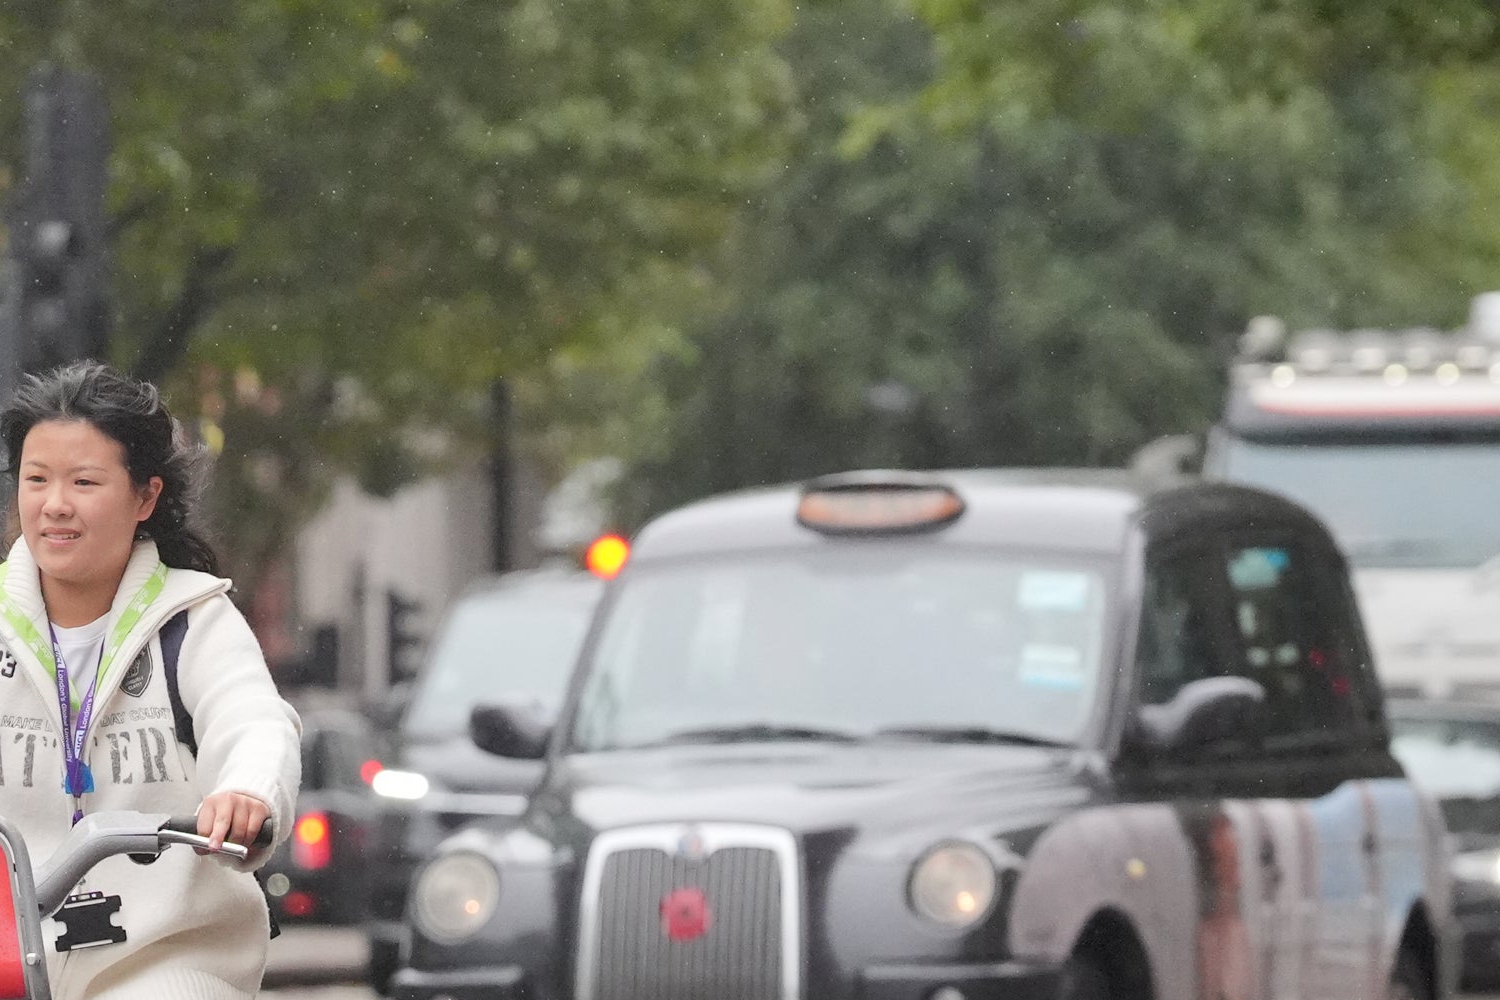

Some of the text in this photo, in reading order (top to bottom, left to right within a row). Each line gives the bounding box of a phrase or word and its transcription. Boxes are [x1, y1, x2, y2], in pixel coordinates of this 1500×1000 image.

[57, 669, 66, 702] London's
[0, 715, 43, 732] MAKE
[100, 711, 126, 727] DAY
[80, 697, 92, 729] London's
